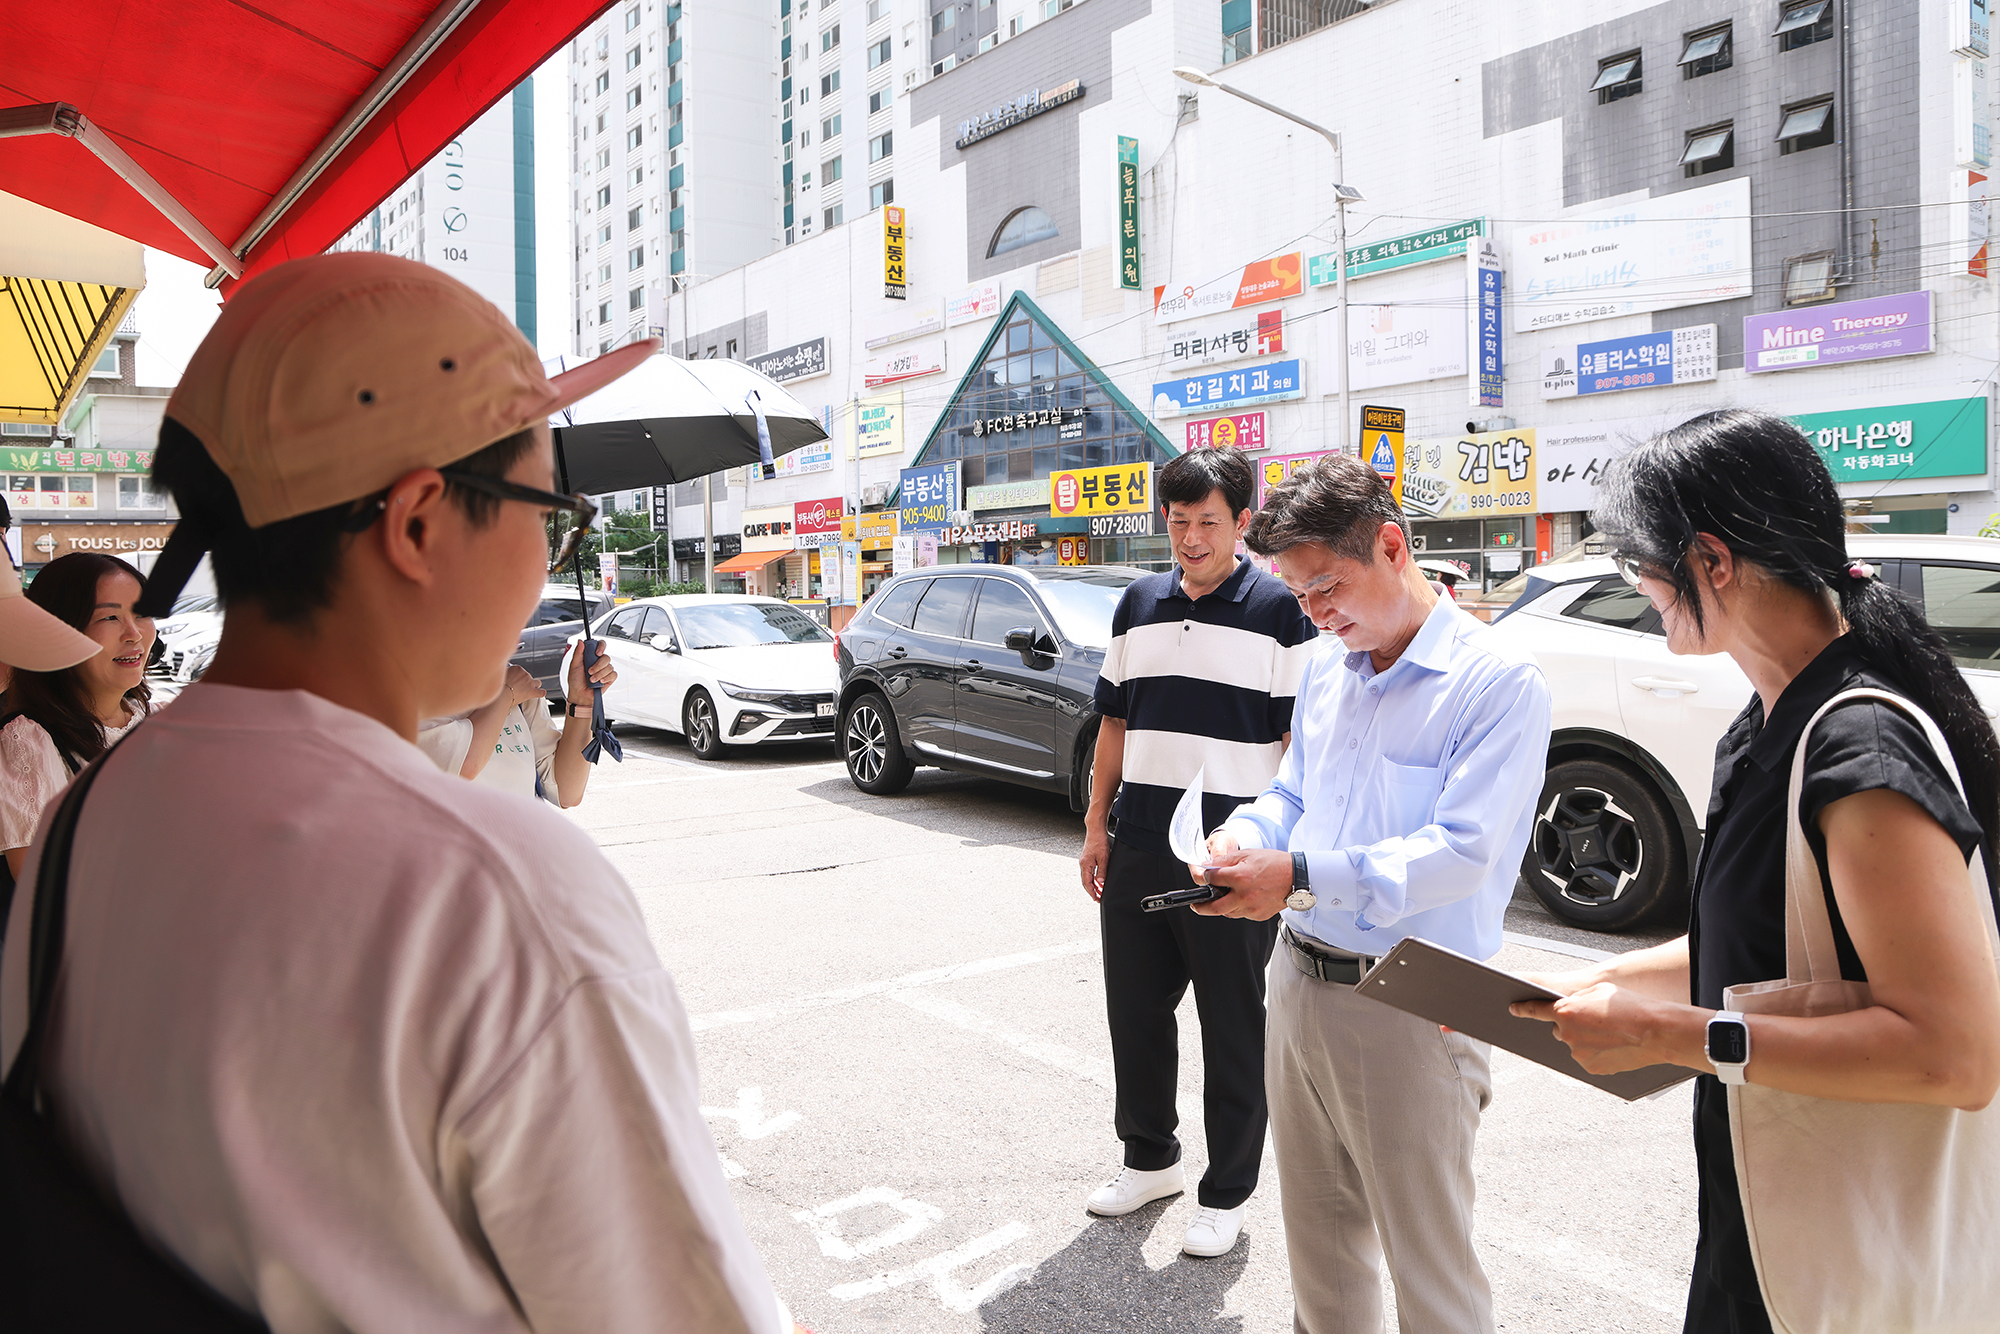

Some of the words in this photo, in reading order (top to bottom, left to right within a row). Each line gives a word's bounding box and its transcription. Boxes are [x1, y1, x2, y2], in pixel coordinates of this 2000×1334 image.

[958, 88, 1040, 138] 대우스포츠센터
[444, 137, 464, 191] GIO
[888, 209, 901, 224] 탑
[1122, 166, 1136, 239] 늘푸른
[886, 226, 904, 282] 부동산
[1377, 243, 1400, 257] 의원
[1413, 230, 1448, 248] 소아과
[1453, 223, 1479, 239] 내과
[1591, 242, 1620, 254] Clinic
[442, 248, 468, 262] 104
[1124, 246, 1138, 283] 의원
[1526, 260, 1640, 301] 스터디매쓰
[1483, 272, 1498, 373] 유플러스학원
[1574, 304, 1617, 320] 수학교습소
[1173, 328, 1251, 360] 머리사랑
[1349, 338, 1376, 358] 네일
[1384, 329, 1430, 351] 그대와
[1762, 325, 1826, 350] Mine
[1831, 311, 1909, 333] Therapy
[1579, 343, 1671, 376] 유플러스학원
[1186, 369, 1270, 403] 한길치과
[1272, 377, 1292, 389] 의원
[1595, 372, 1655, 389] 907-8818
[987, 414, 1014, 434] FC현
[1016, 406, 1062, 430] 축구교실
[1239, 415, 1261, 444] 수선
[1367, 411, 1403, 428] 어린이보호구역
[1546, 437, 1562, 446] Hair
[1562, 433, 1607, 446] professional
[1816, 420, 1913, 452] 하나은행
[54, 450, 156, 469] 보리밥집
[1403, 444, 1441, 474] 웰빙
[1458, 437, 1532, 485] 김밥
[1843, 452, 1914, 470] 자동화코너
[17, 494, 88, 506] 삼겹살
[902, 473, 944, 503] 부동산
[1008, 486, 1040, 502] 인테리어
[1057, 479, 1077, 508] 탑
[1082, 470, 1146, 509] 부동산
[1470, 491, 1531, 509] 990-0023
[902, 504, 946, 526] 905-9400
[1091, 514, 1147, 536] 907-2800
[68, 537, 113, 550] TOUS
[115, 537, 137, 550] les
[137, 537, 170, 551] JOU
[941, 519, 1023, 547] 대우스포츠센터
[1061, 542, 1073, 558] 탑
[1077, 541, 1087, 558] 탑
[820, 704, 835, 715] 17
